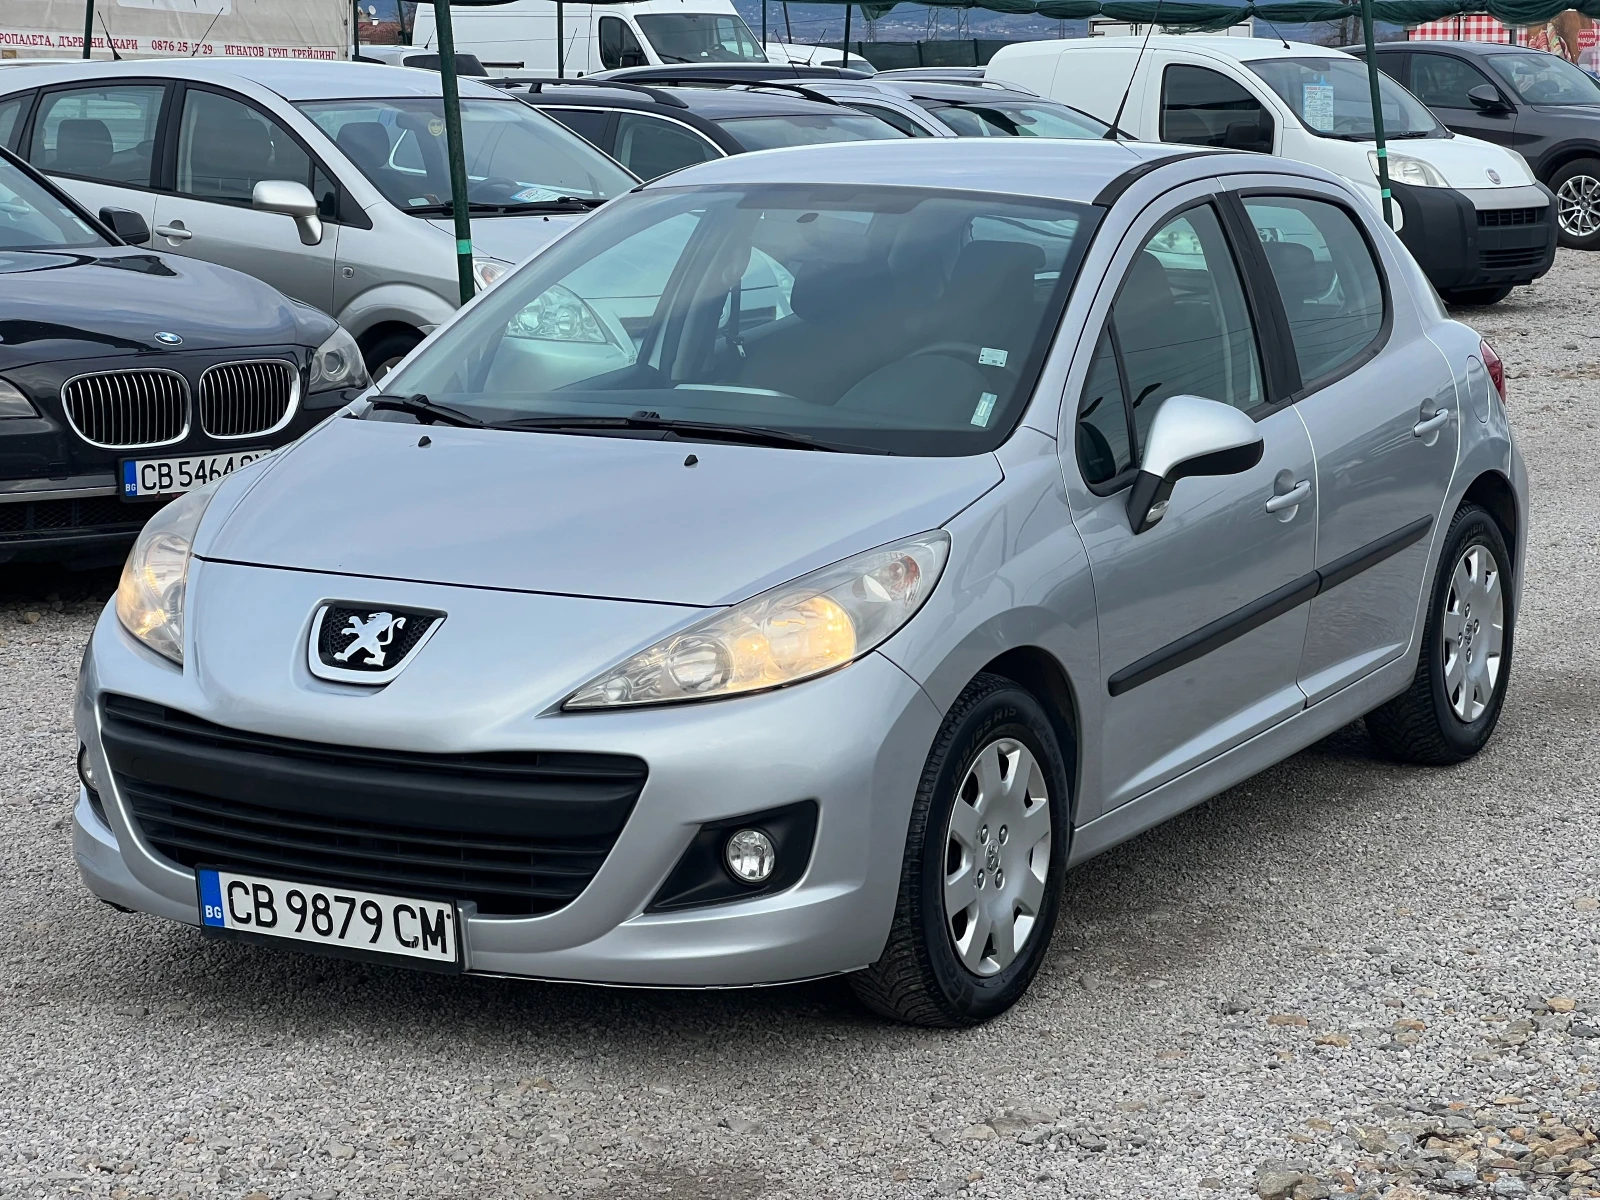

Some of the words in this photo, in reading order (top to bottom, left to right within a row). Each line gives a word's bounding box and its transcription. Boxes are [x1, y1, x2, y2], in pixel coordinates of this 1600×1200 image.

[58, 35, 104, 48] ДЪРВНИ
[152, 39, 174, 51] 0876
[177, 41, 188, 53] 25
[202, 44, 213, 55] 29
[224, 45, 265, 57] ИГНАТОВ
[268, 47, 288, 58] ГРУП
[125, 484, 137, 492] BG
[141, 462, 173, 491] CB
[205, 904, 222, 919] BG
[227, 880, 278, 928] CB
[286, 889, 383, 944] 9879
[393, 904, 447, 954] CM
